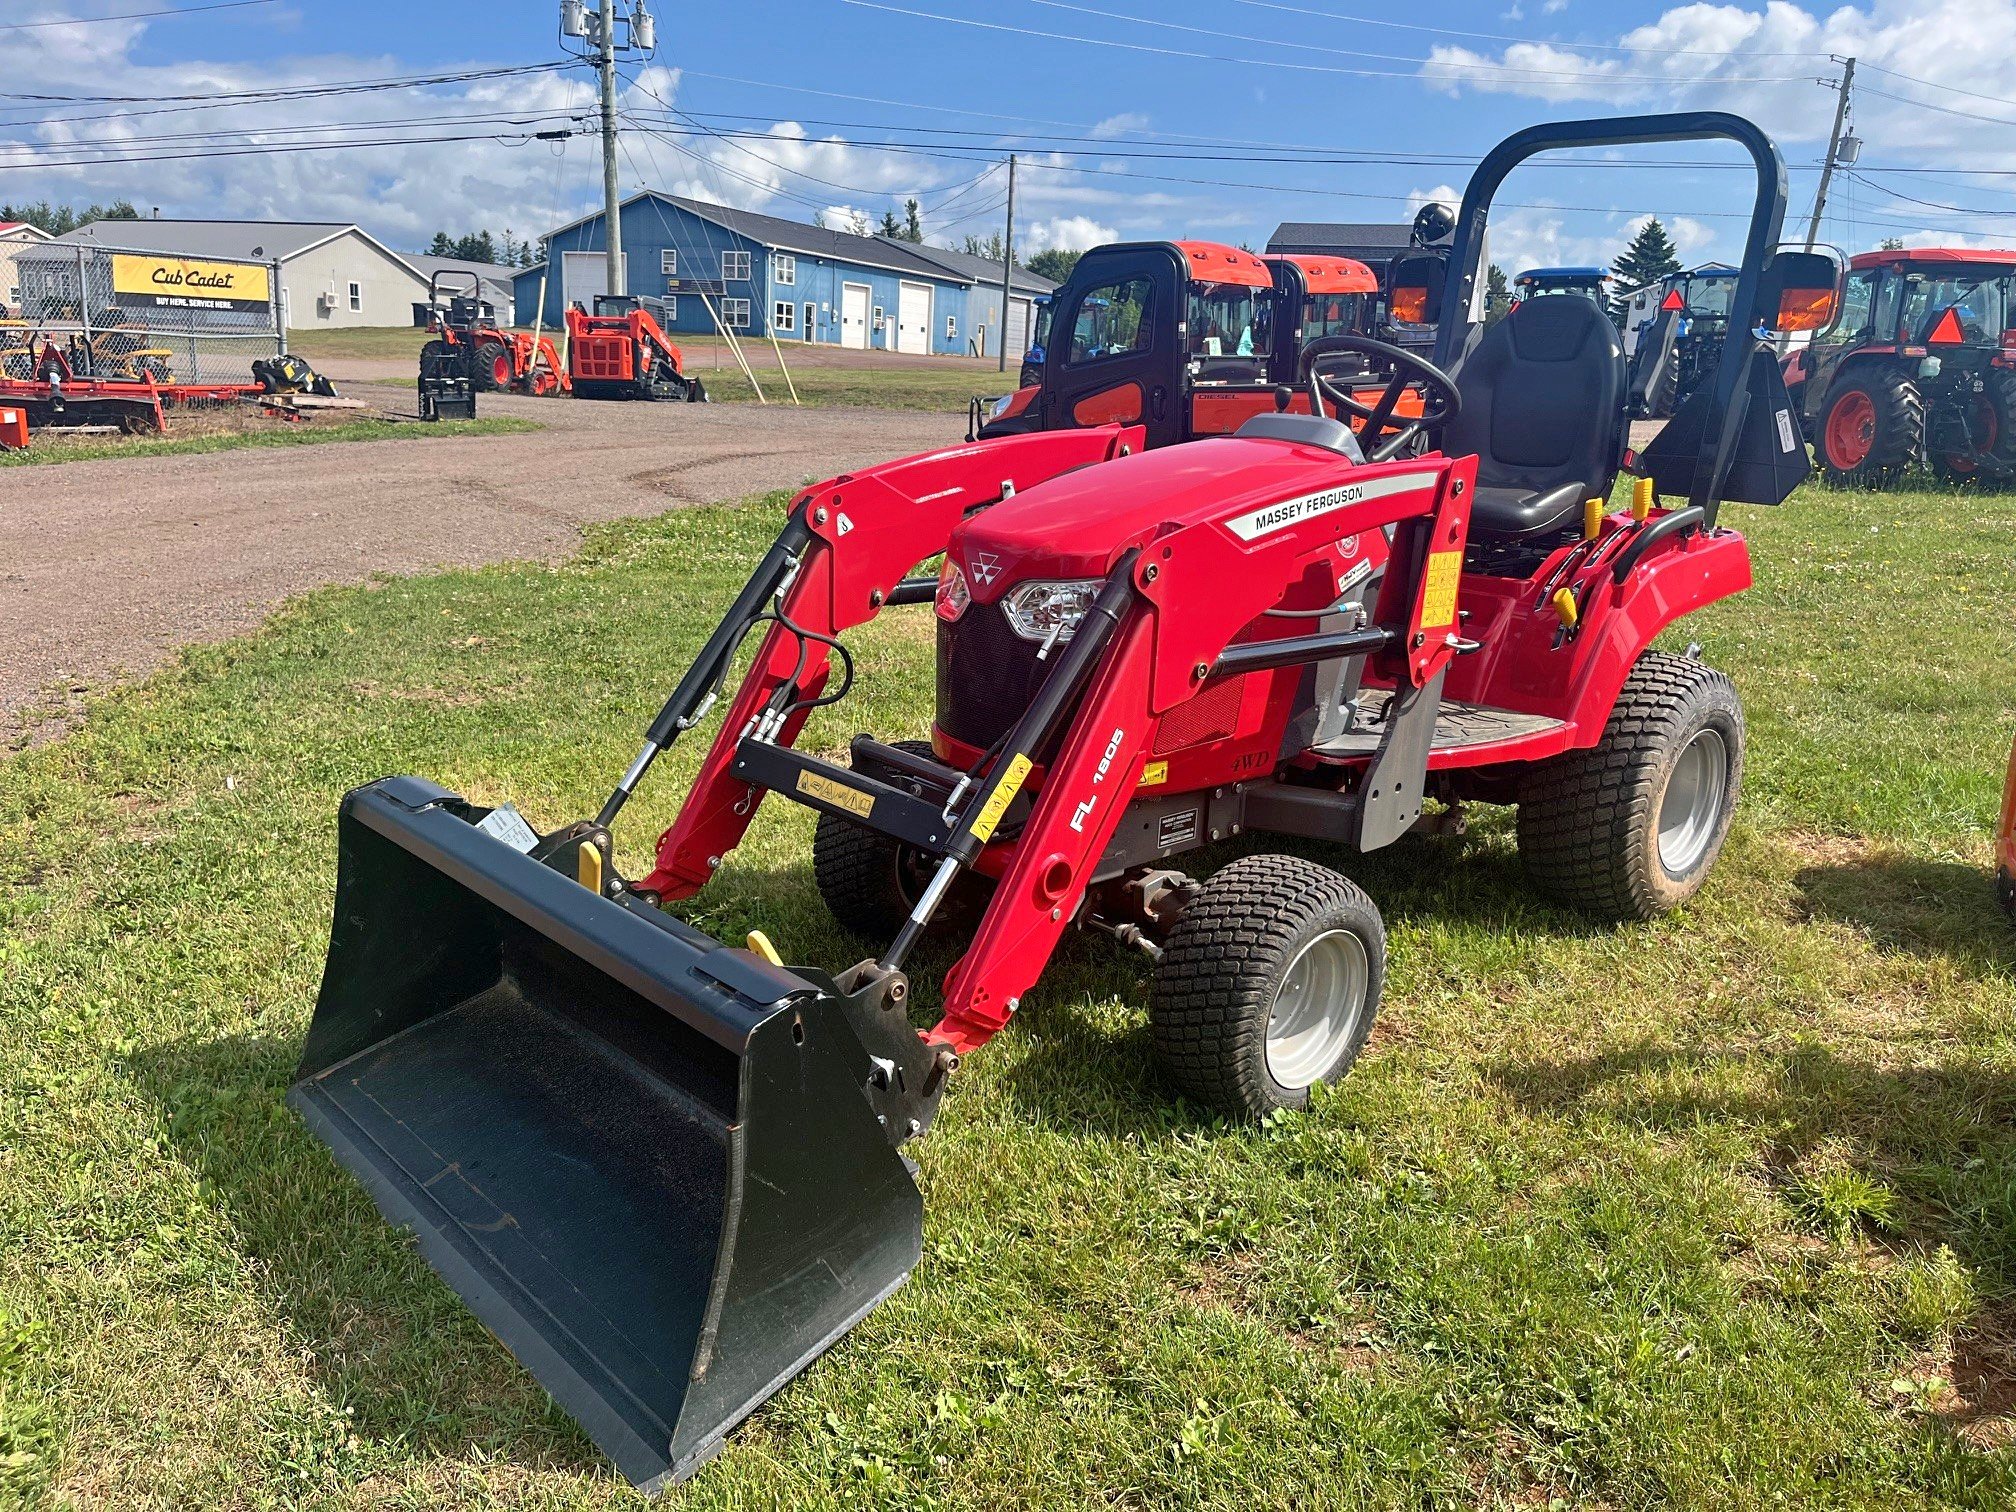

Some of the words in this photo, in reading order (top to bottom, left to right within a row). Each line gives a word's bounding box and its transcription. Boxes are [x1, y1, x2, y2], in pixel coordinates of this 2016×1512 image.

[152, 267, 183, 285] Cub
[185, 270, 235, 289] Cadet
[156, 297, 169, 306] BUY
[169, 298, 189, 307] HERE.
[188, 299, 215, 308] SERVICE
[215, 300, 234, 309] HERE.
[1256, 502, 1303, 531] MASSEY
[1306, 485, 1364, 513] FERGUSON
[1231, 751, 1270, 773] 4WD
[1069, 794, 1098, 833] FL
[1092, 727, 1125, 785] 1805
